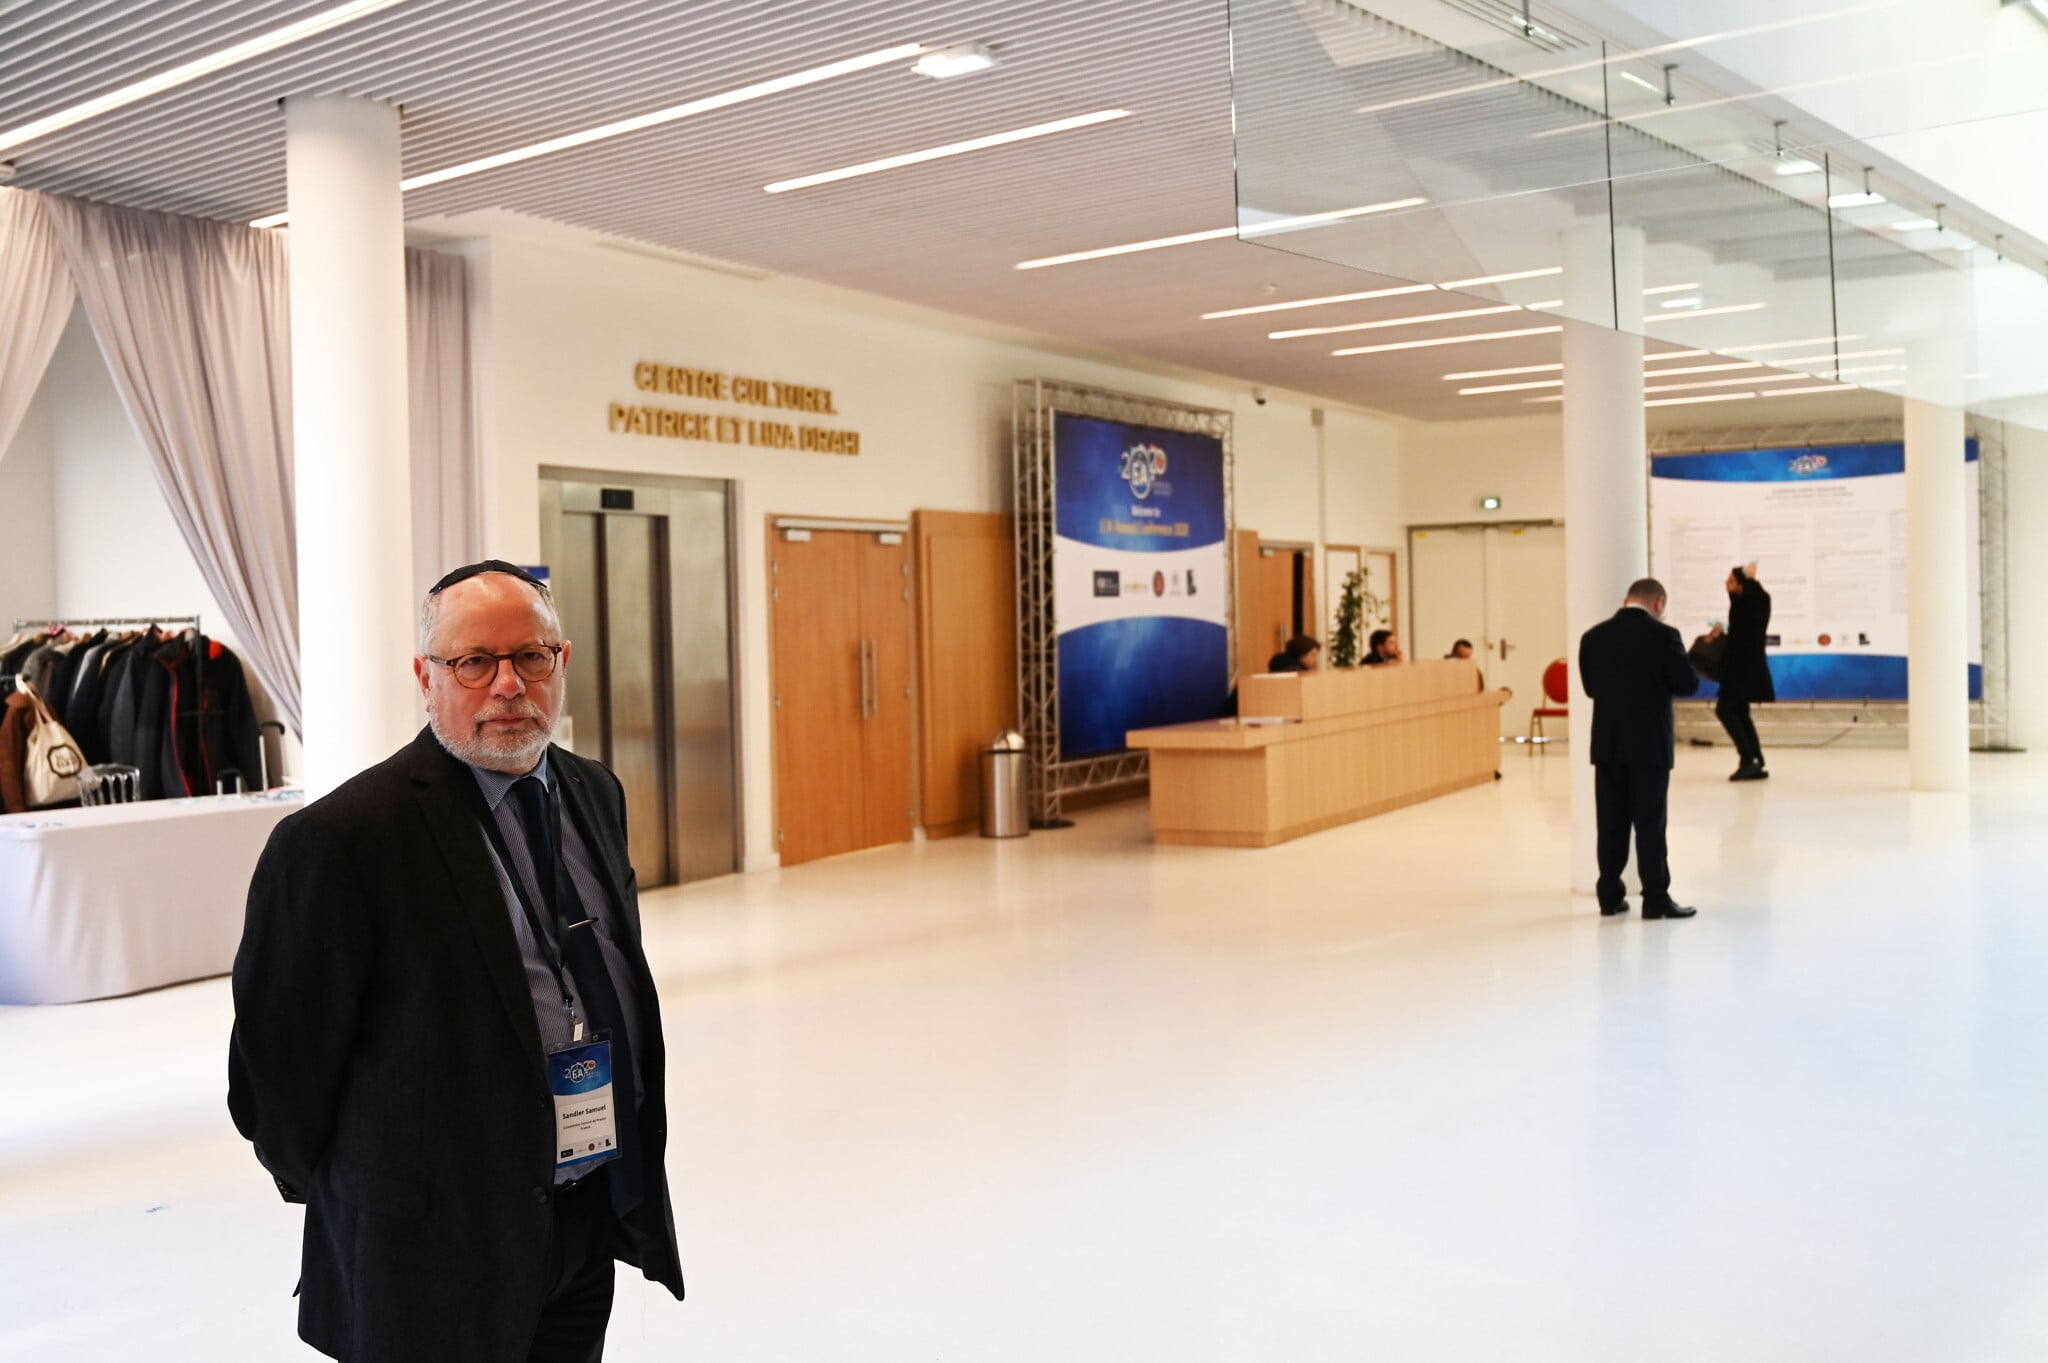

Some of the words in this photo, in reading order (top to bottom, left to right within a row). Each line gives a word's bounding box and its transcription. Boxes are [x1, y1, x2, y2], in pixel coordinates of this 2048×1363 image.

[634, 362, 728, 401] CENTRE
[732, 376, 839, 416] CULTUREL
[608, 403, 713, 443] PATRICK
[716, 415, 744, 445] ET
[748, 420, 796, 450] LINA
[562, 1109, 585, 1120] Sandler
[585, 1104, 607, 1115] Samuel
